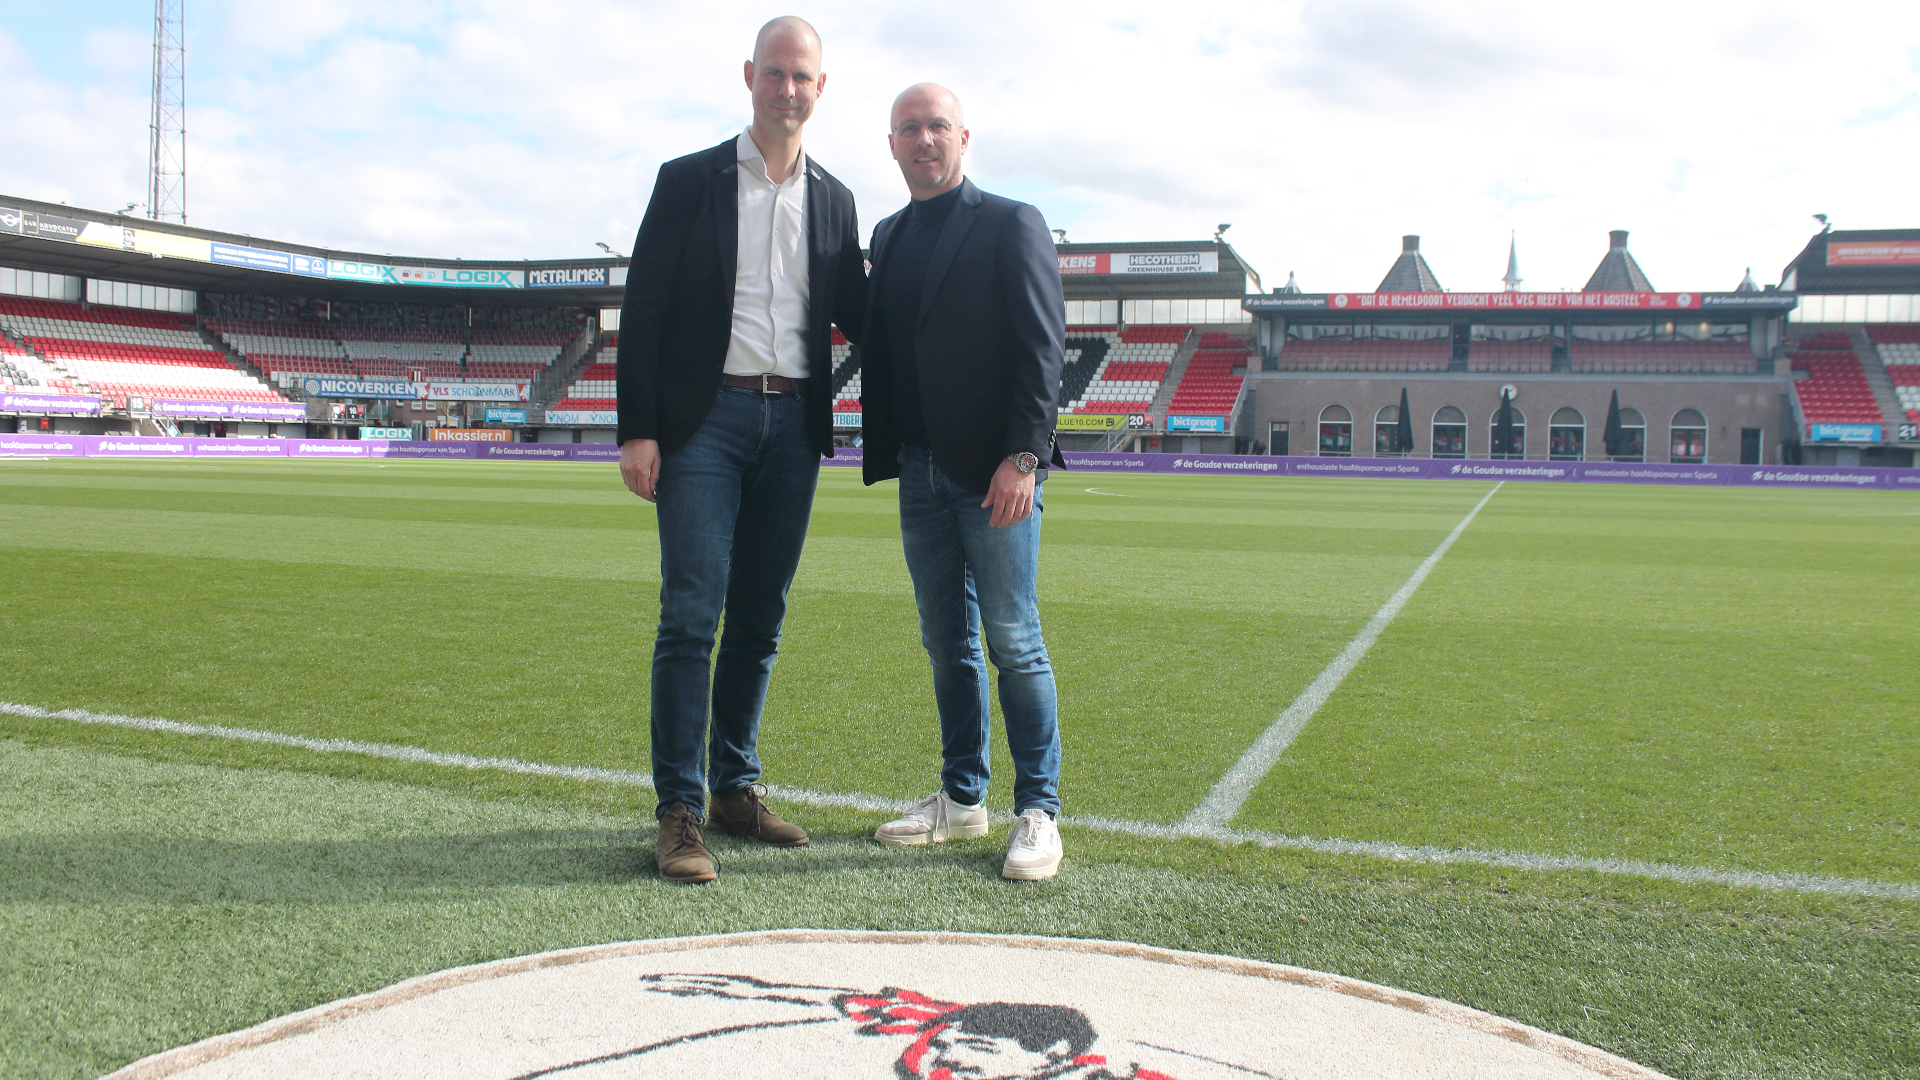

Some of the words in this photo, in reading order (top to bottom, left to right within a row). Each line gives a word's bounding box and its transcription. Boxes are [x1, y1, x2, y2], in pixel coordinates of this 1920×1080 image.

[40, 222, 78, 234] ADVOCATEN
[1058, 256, 1096, 268] KENS
[1130, 254, 1199, 265] HECOTHERM
[330, 261, 400, 284] LOGIX
[529, 268, 604, 284] METALIMEX
[442, 270, 517, 287] LOGIX
[1282, 298, 1324, 306] verzekeringen
[1378, 294, 1390, 306] DE
[1391, 294, 1444, 306] HEMELPOORT
[1492, 294, 1513, 306] VEEL
[1516, 294, 1534, 306] WEG
[1536, 294, 1562, 306] HEEFT
[1565, 294, 1583, 306] VAN
[1584, 294, 1601, 306] HET
[321, 380, 416, 394] NICOVERKEN
[433, 387, 449, 396] VLS
[451, 387, 515, 396] SCHOONMAAK
[14, 397, 23, 406] de
[24, 398, 50, 407] Goudse
[51, 400, 100, 410] verzekeringen
[132, 398, 143, 408] 15
[163, 403, 185, 412] Goudse
[488, 410, 522, 420] bictgroep
[556, 414, 579, 424] NOM
[1057, 418, 1104, 426] LUE10.COM
[1130, 416, 1144, 426] 20
[1173, 417, 1217, 428] bictgroep
[366, 428, 412, 438] LOGIX
[435, 430, 506, 441] Inkassier.nl
[1820, 425, 1873, 438] bictgroep
[1899, 425, 1916, 437] 21
[1, 442, 42, 450] hoofdsponsor
[54, 442, 73, 450] Sparta
[108, 442, 116, 450] de
[117, 442, 140, 451] Goudse
[141, 443, 183, 452] verzekeringen
[524, 448, 564, 456] verzekeringen
[1070, 459, 1112, 467] hoofdsponsor
[1184, 459, 1192, 468] de
[1194, 460, 1222, 469] Goudse
[1223, 461, 1278, 471] verzekeringen
[1339, 464, 1384, 472] hoofdsponsor
[1397, 465, 1419, 473] Sparta
[1462, 466, 1472, 474] de
[1473, 466, 1503, 475] Goudse
[1505, 466, 1564, 477] verzekeringen
[1630, 470, 1678, 479] hoofdsponsor
[1694, 471, 1717, 479] Sparta
[1763, 472, 1775, 481] de
[1776, 472, 1809, 482] Goudse
[1810, 473, 1876, 484] verzekeringen
